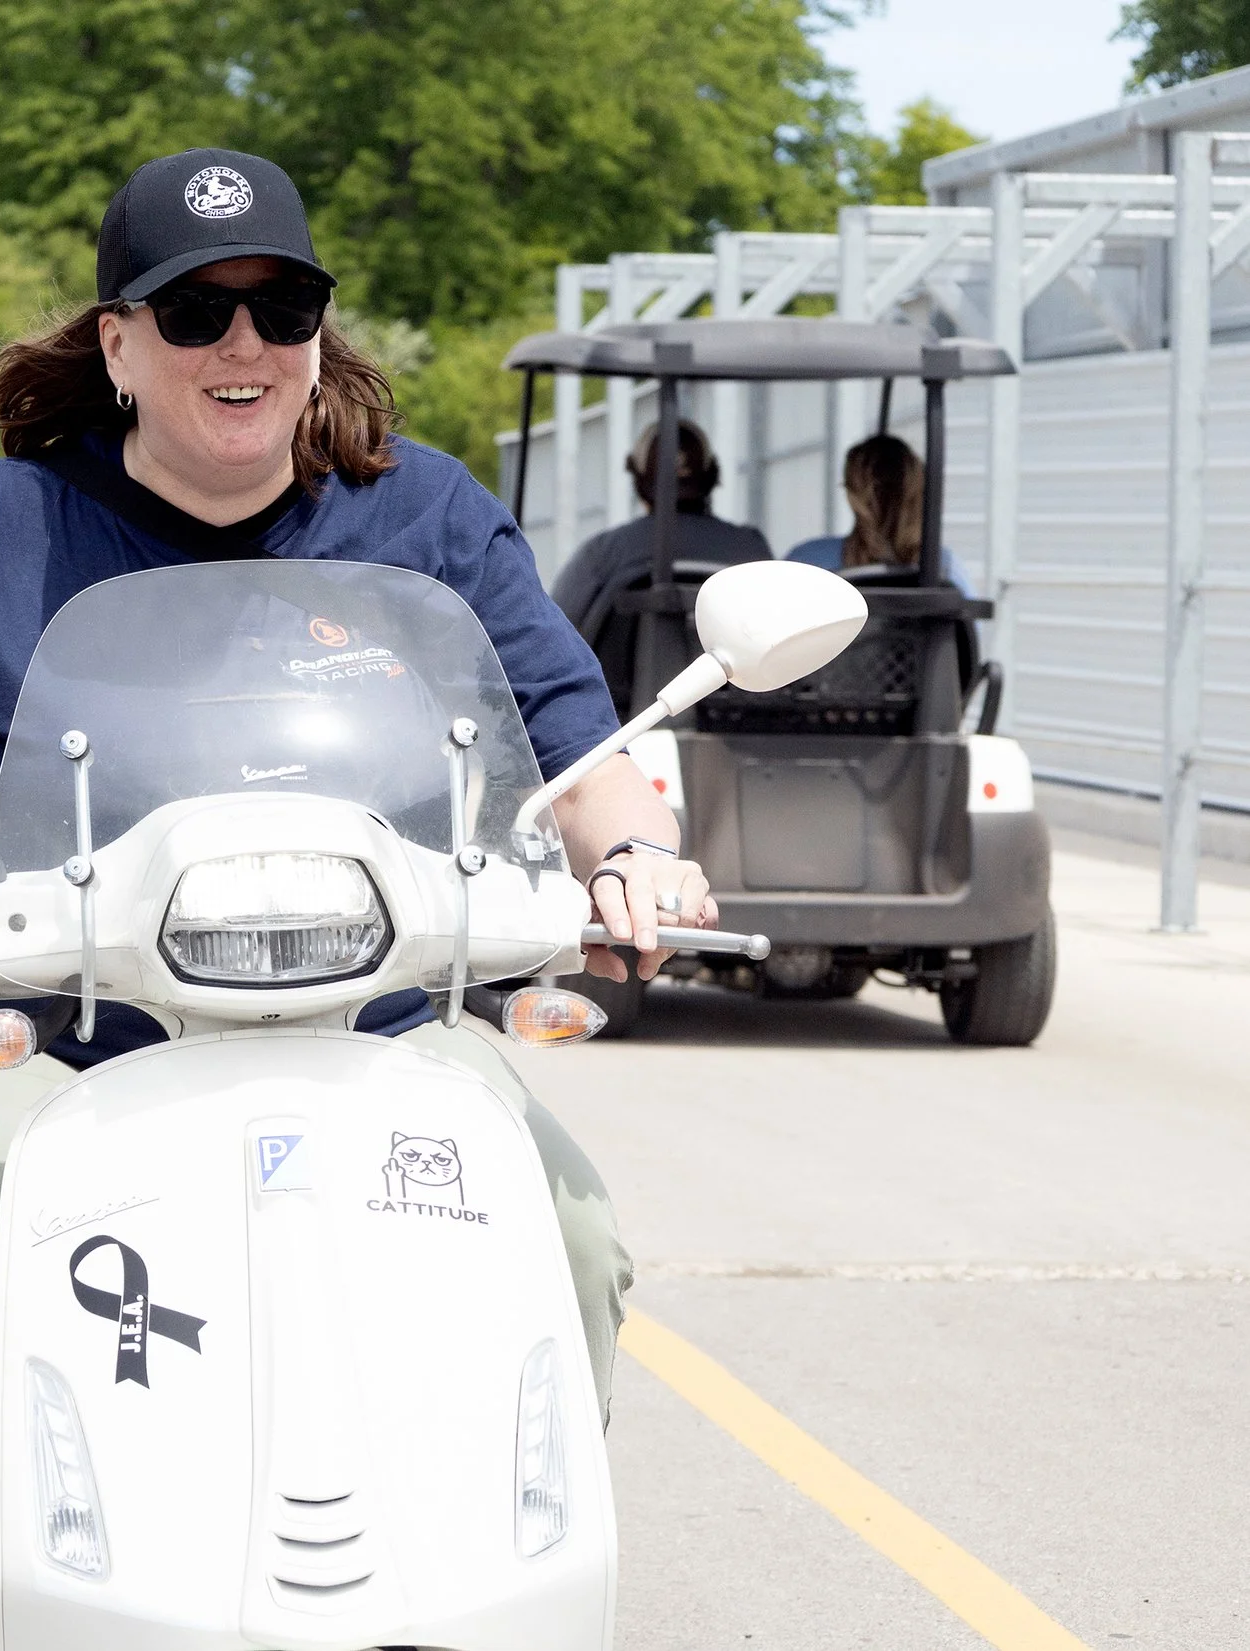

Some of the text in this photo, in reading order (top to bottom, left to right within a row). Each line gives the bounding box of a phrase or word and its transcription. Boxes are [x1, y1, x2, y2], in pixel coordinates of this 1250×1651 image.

[315, 662, 391, 682] RACING
[366, 1199, 489, 1225] CATTITUDE
[120, 1294, 145, 1354] J.E.A.
